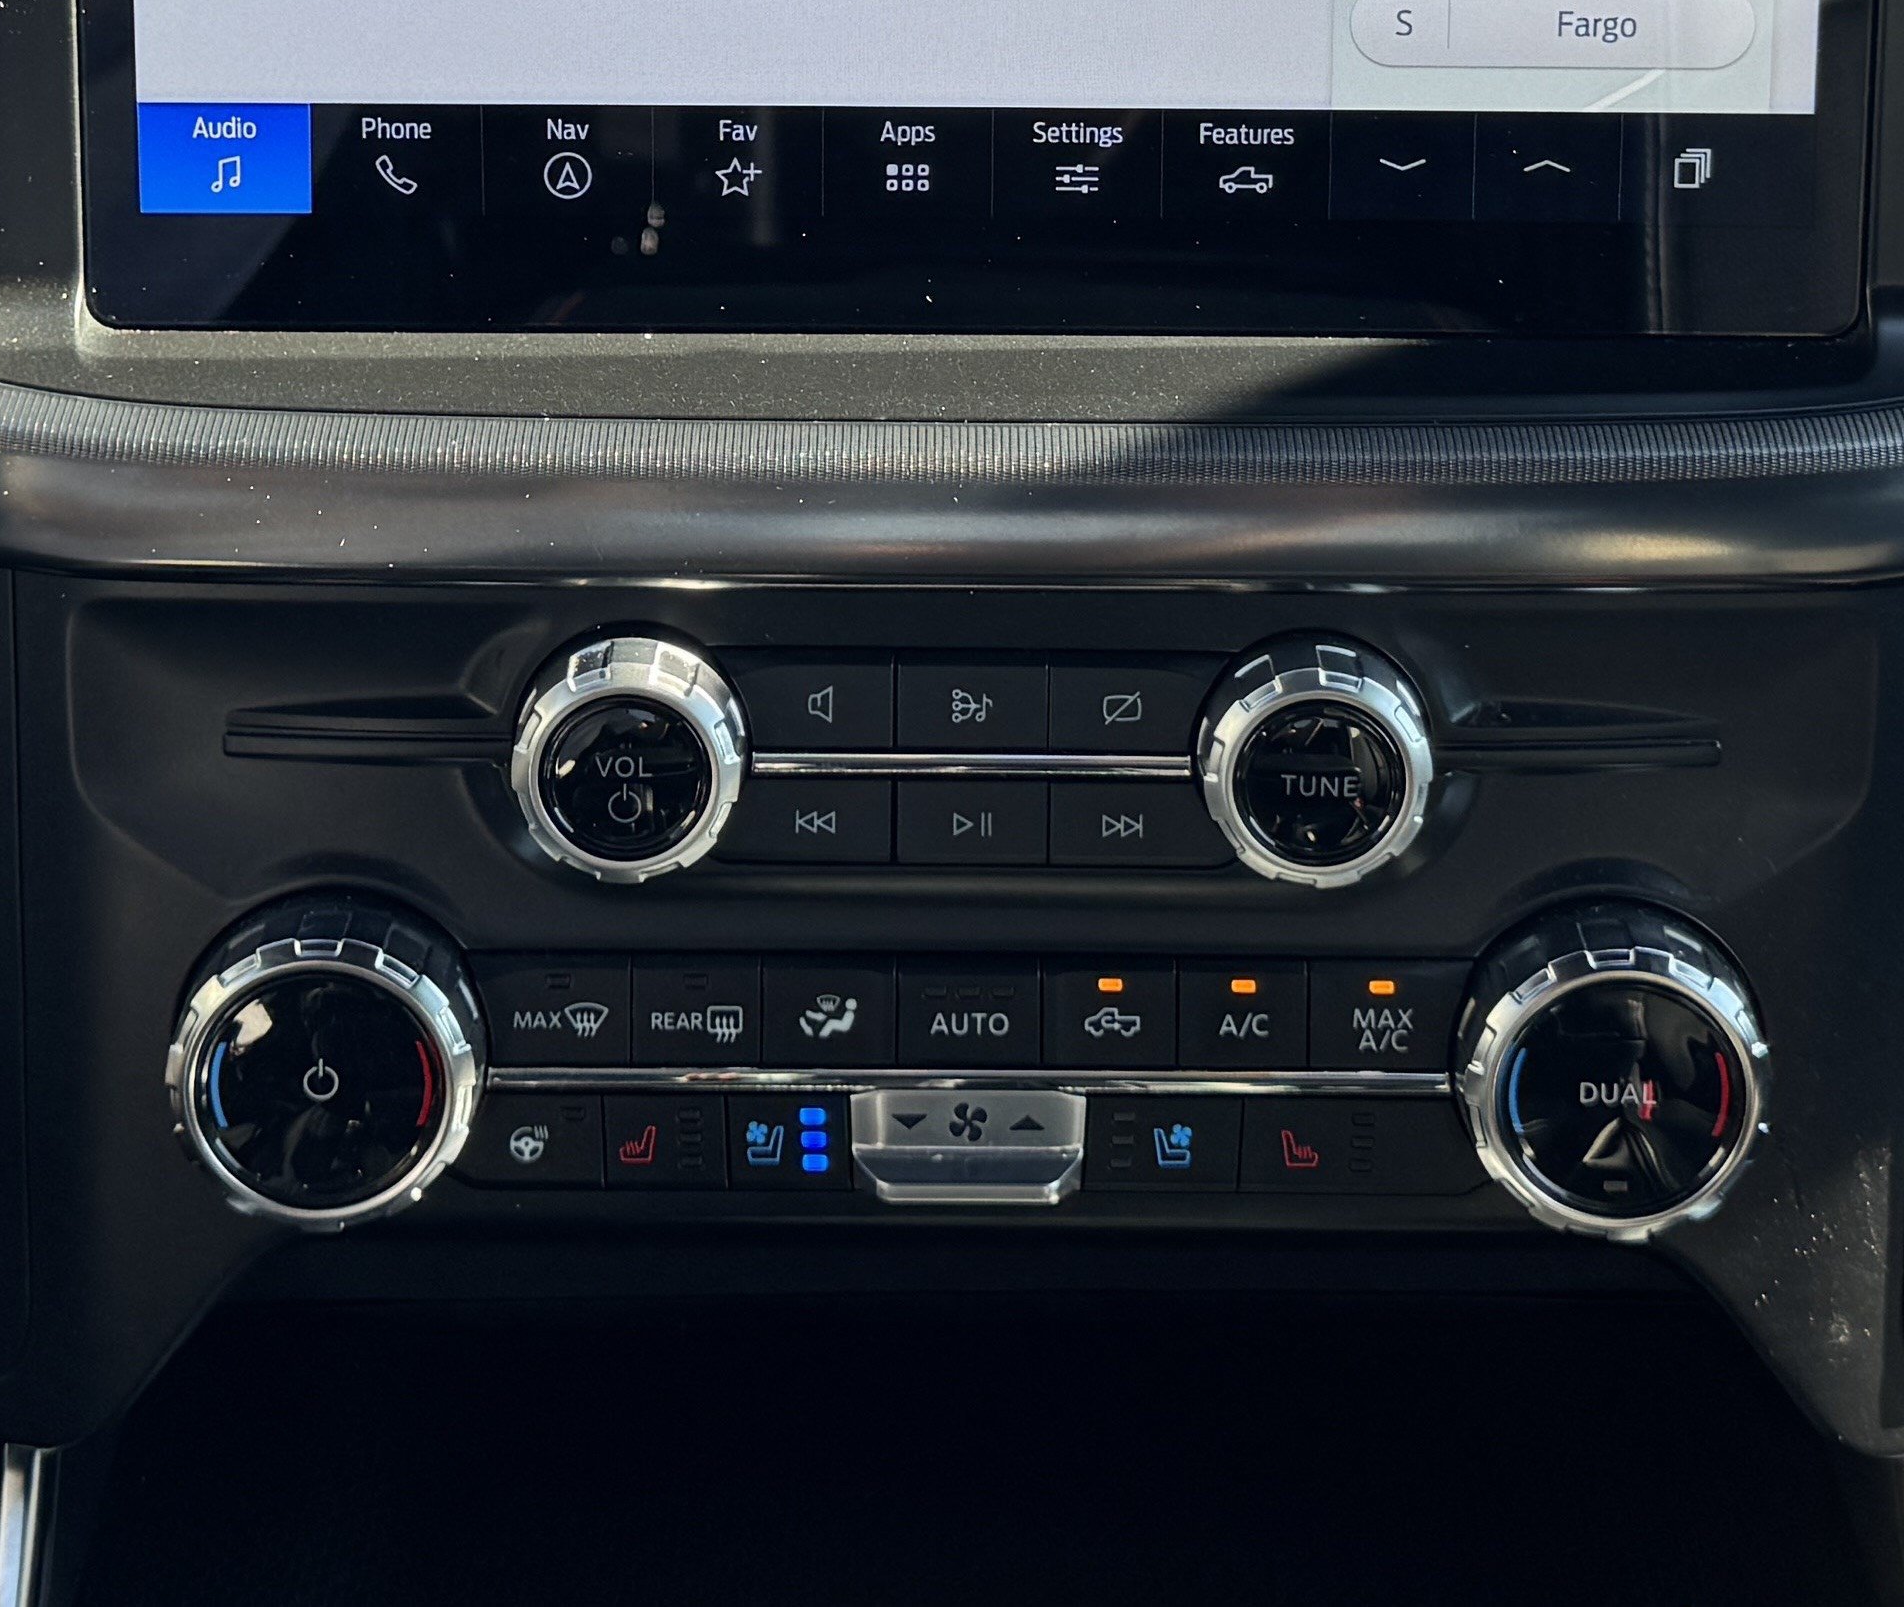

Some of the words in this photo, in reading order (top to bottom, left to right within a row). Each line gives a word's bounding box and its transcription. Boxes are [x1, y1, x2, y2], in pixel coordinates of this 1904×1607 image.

[1395, 10, 1413, 37] S
[1557, 10, 1637, 42] Fargo
[192, 116, 257, 140] Audio
[361, 118, 432, 140] Phone
[546, 119, 589, 140] Nav
[718, 120, 757, 141] Fav
[880, 121, 936, 145] Apps
[1032, 121, 1123, 145] Settings
[1199, 123, 1295, 145] Features
[595, 754, 653, 778] VOL
[1280, 774, 1358, 798] TUNE
[513, 1012, 562, 1031] MAX
[651, 1011, 702, 1031] REAR
[929, 1012, 1010, 1037] AUTO
[1219, 1014, 1270, 1038] A/C
[1353, 1009, 1413, 1030] MAX
[1358, 1029, 1409, 1052] A/C
[1579, 1082, 1656, 1106] DUAL
